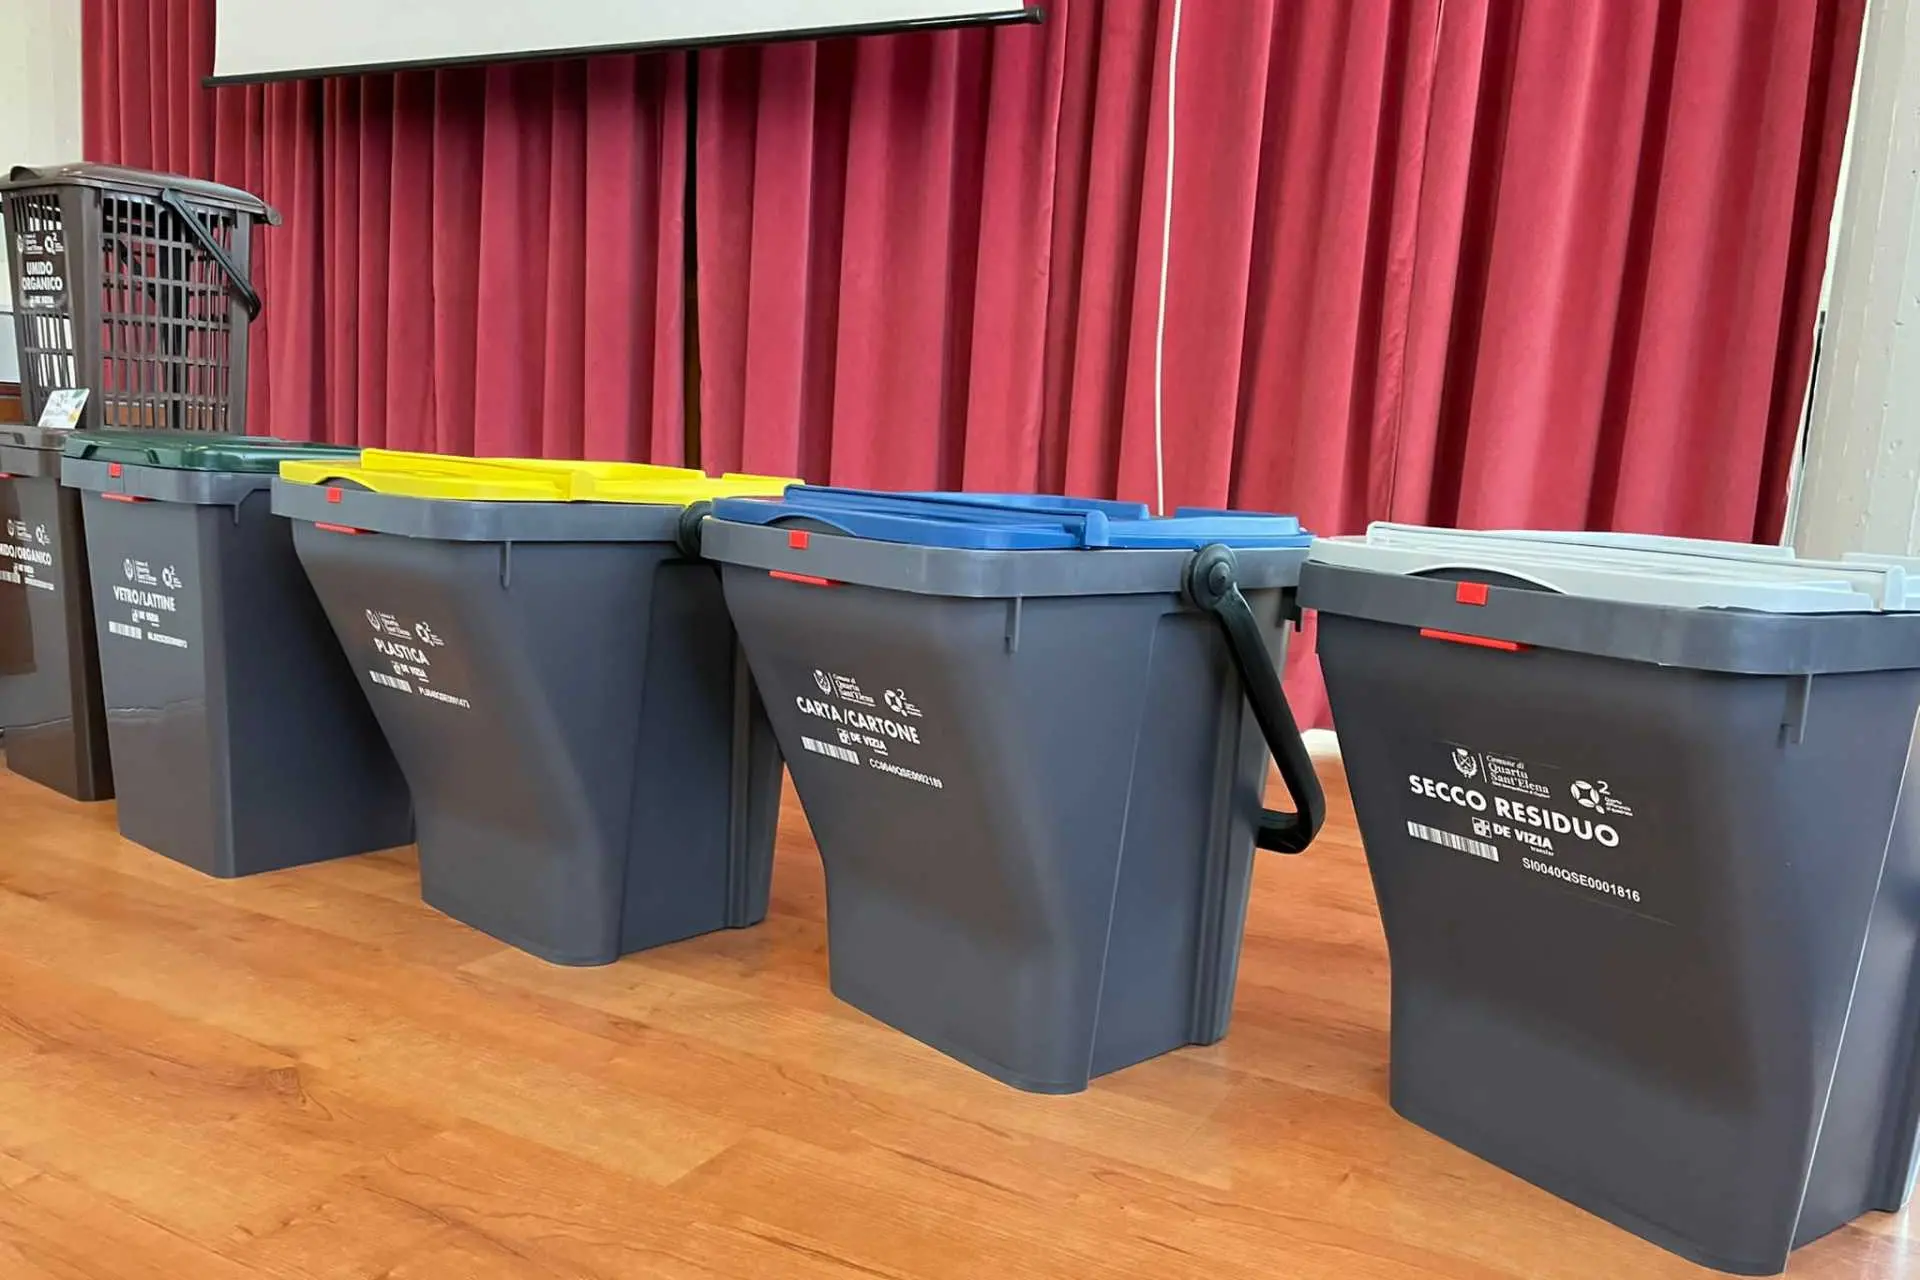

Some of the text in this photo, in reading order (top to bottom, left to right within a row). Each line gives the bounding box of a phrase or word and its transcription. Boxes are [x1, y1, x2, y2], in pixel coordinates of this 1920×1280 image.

[26, 261, 53, 275] UMIDO
[22, 276, 63, 291] ORGANICO
[113, 585, 176, 612] VETRO/LATTINE
[373, 637, 431, 666] PLASTICA
[1488, 762, 1528, 779] Quartu
[1490, 772, 1550, 794] Sant'Elena
[1408, 774, 1487, 812] SECCO
[1494, 796, 1620, 848] RESIDUO
[1492, 822, 1553, 850] DE VIZIA
[1522, 857, 1641, 902] SI0040QSE0001816
